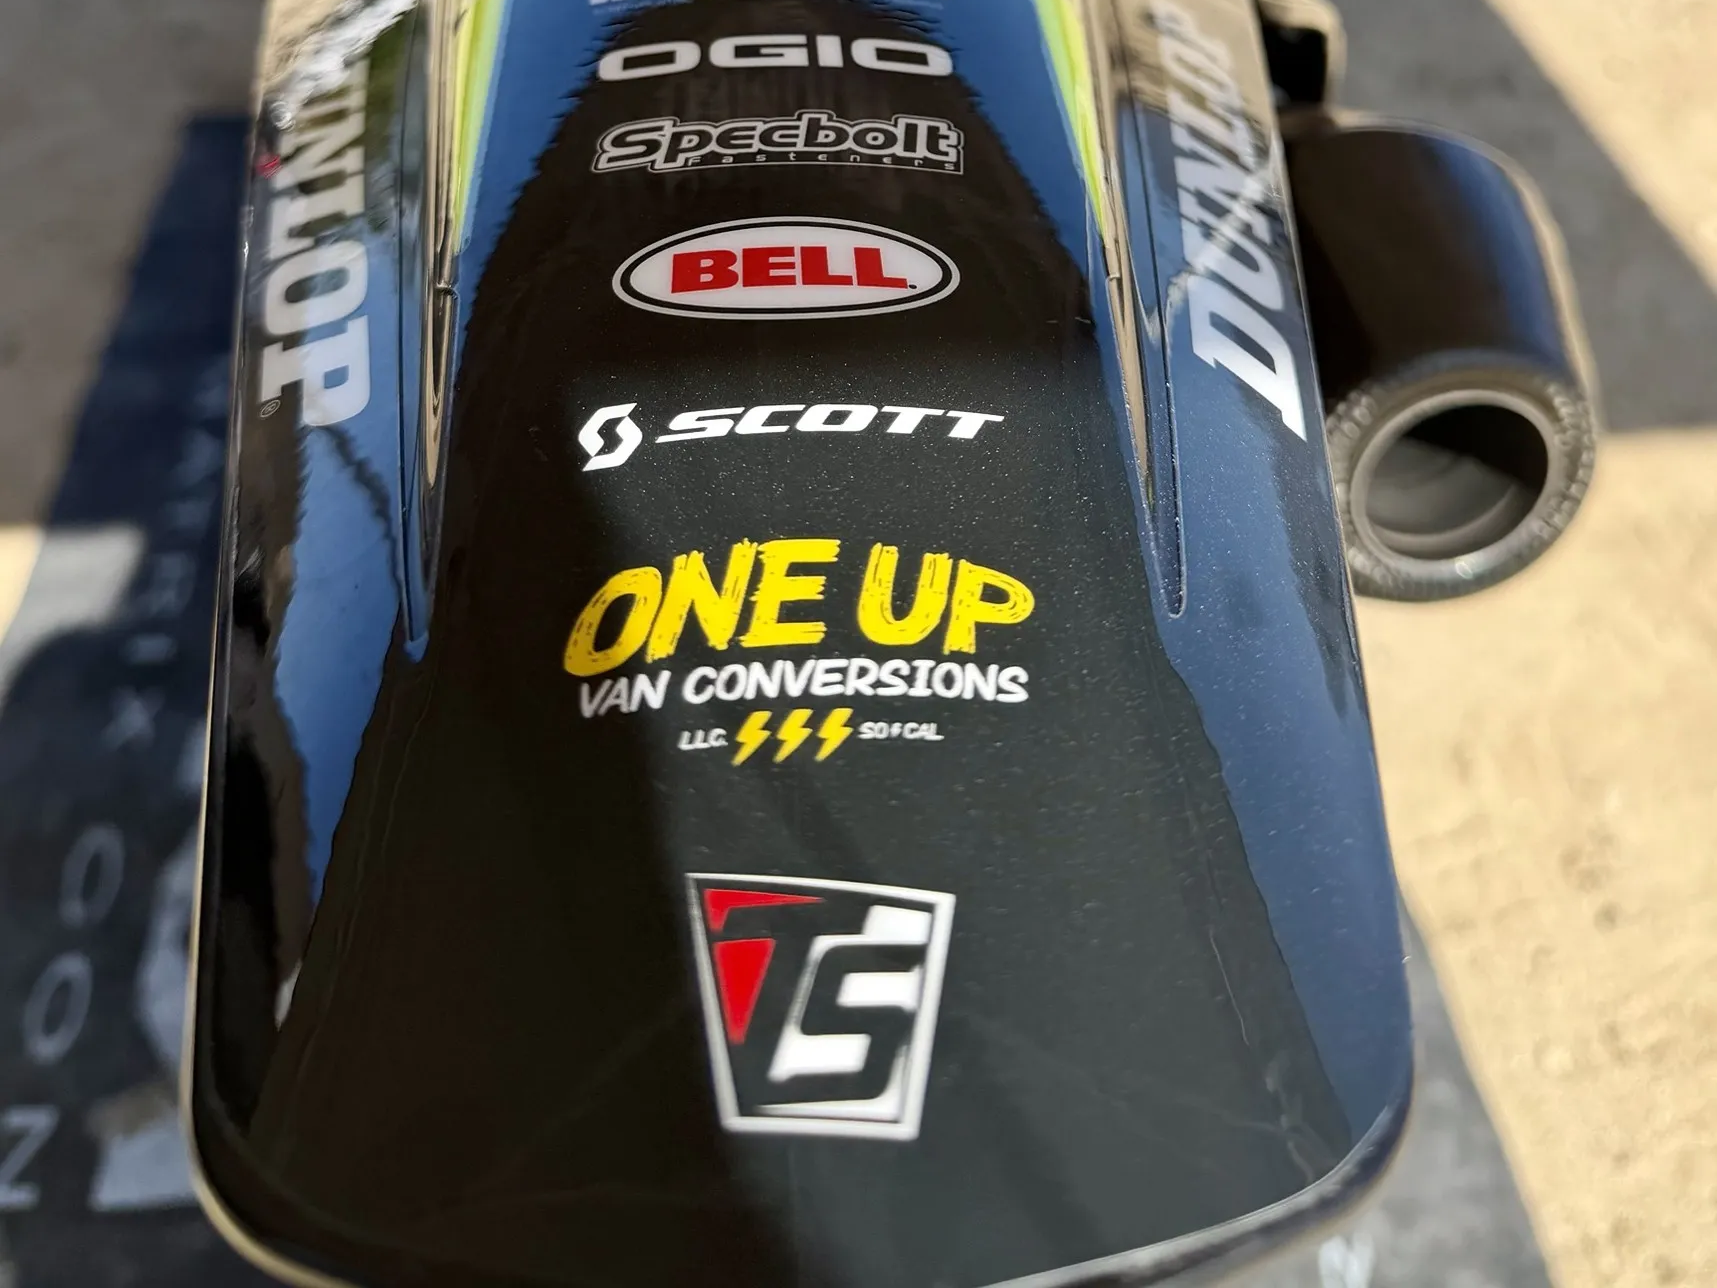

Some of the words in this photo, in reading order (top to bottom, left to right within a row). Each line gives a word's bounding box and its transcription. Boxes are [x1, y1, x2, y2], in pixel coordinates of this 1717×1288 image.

[597, 34, 954, 82] OGIO
[671, 245, 909, 294] BELL
[655, 404, 1005, 444] SCOTT
[563, 538, 841, 677] ONE
[857, 541, 1035, 655] UP
[579, 669, 672, 718] VAN
[681, 657, 1030, 703] CONVERSIONS
